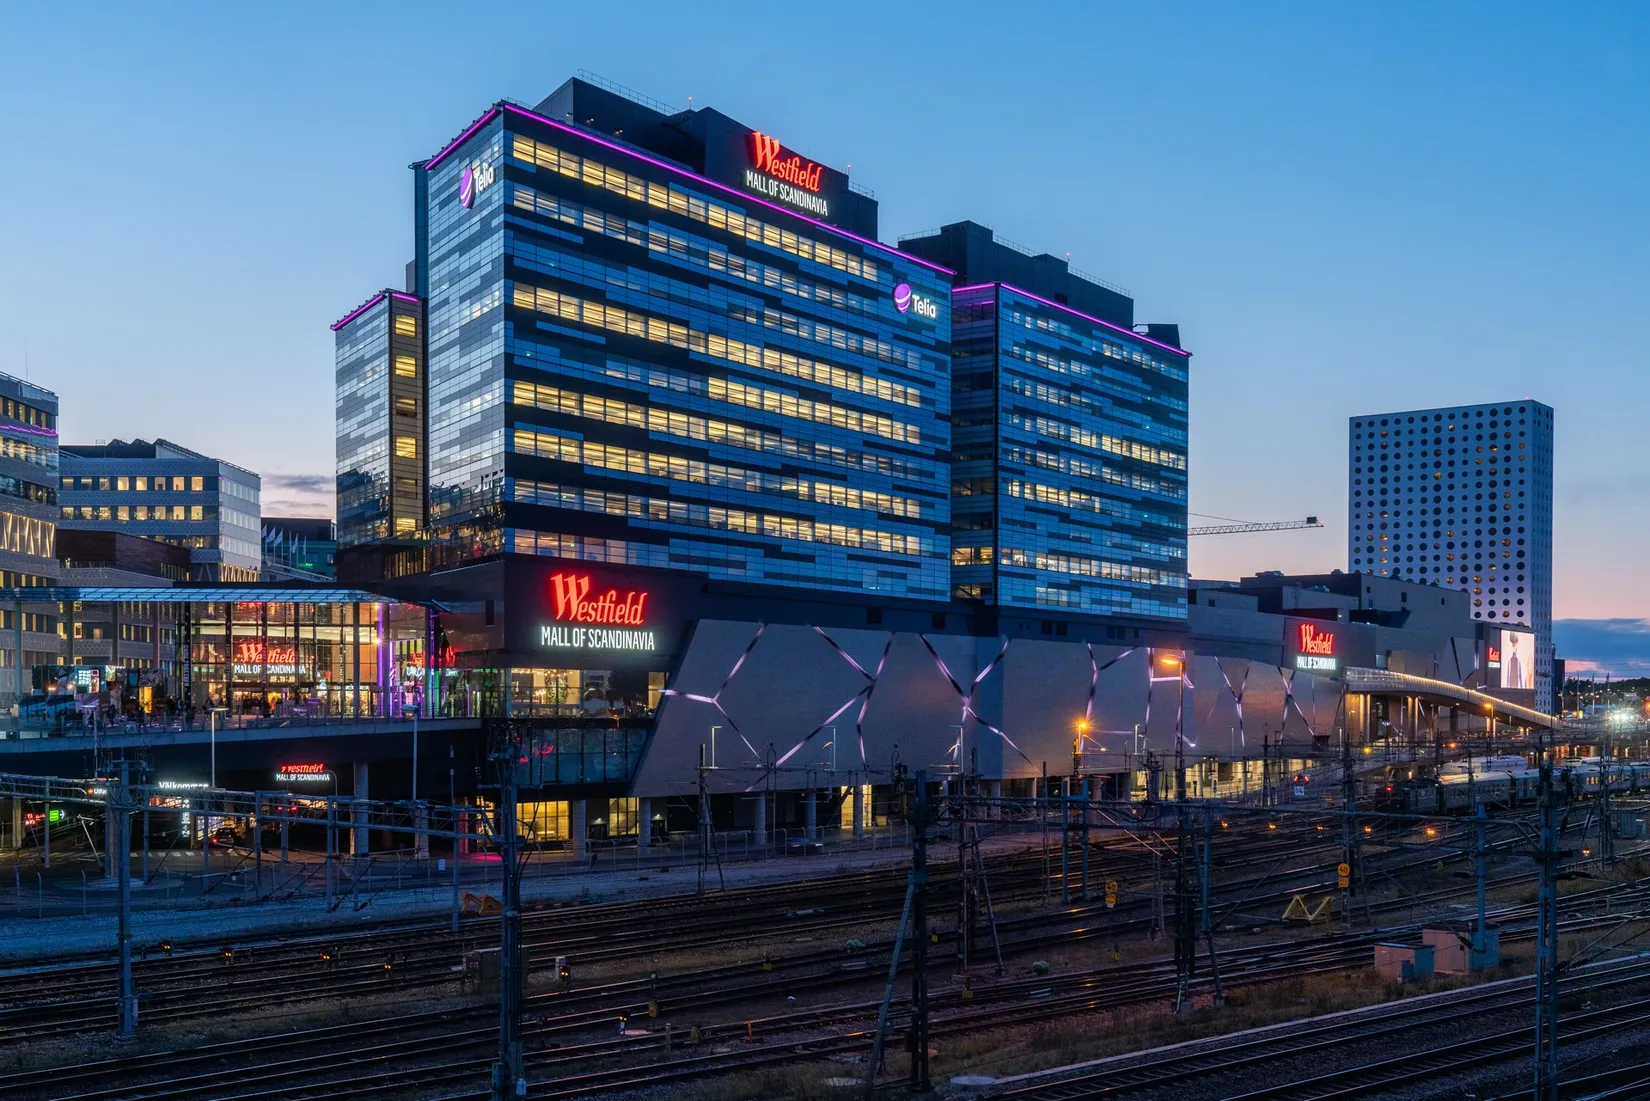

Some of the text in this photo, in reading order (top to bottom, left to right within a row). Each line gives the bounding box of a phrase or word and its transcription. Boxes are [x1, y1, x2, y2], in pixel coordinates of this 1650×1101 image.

[752, 131, 823, 192] Westfield
[473, 162, 494, 193] Telia
[746, 170, 828, 216] MALL OF SCANDINAVIA
[912, 294, 936, 318] Telia
[550, 573, 648, 625] Westfield
[541, 626, 655, 650] MALL OF SCANDINAVIA
[1300, 623, 1334, 654] Westfield
[239, 642, 295, 664] Wetfiel
[233, 664, 306, 674] MALL OF CANDINAIA
[276, 773, 330, 781] MALL OF SCANDINAVIA
